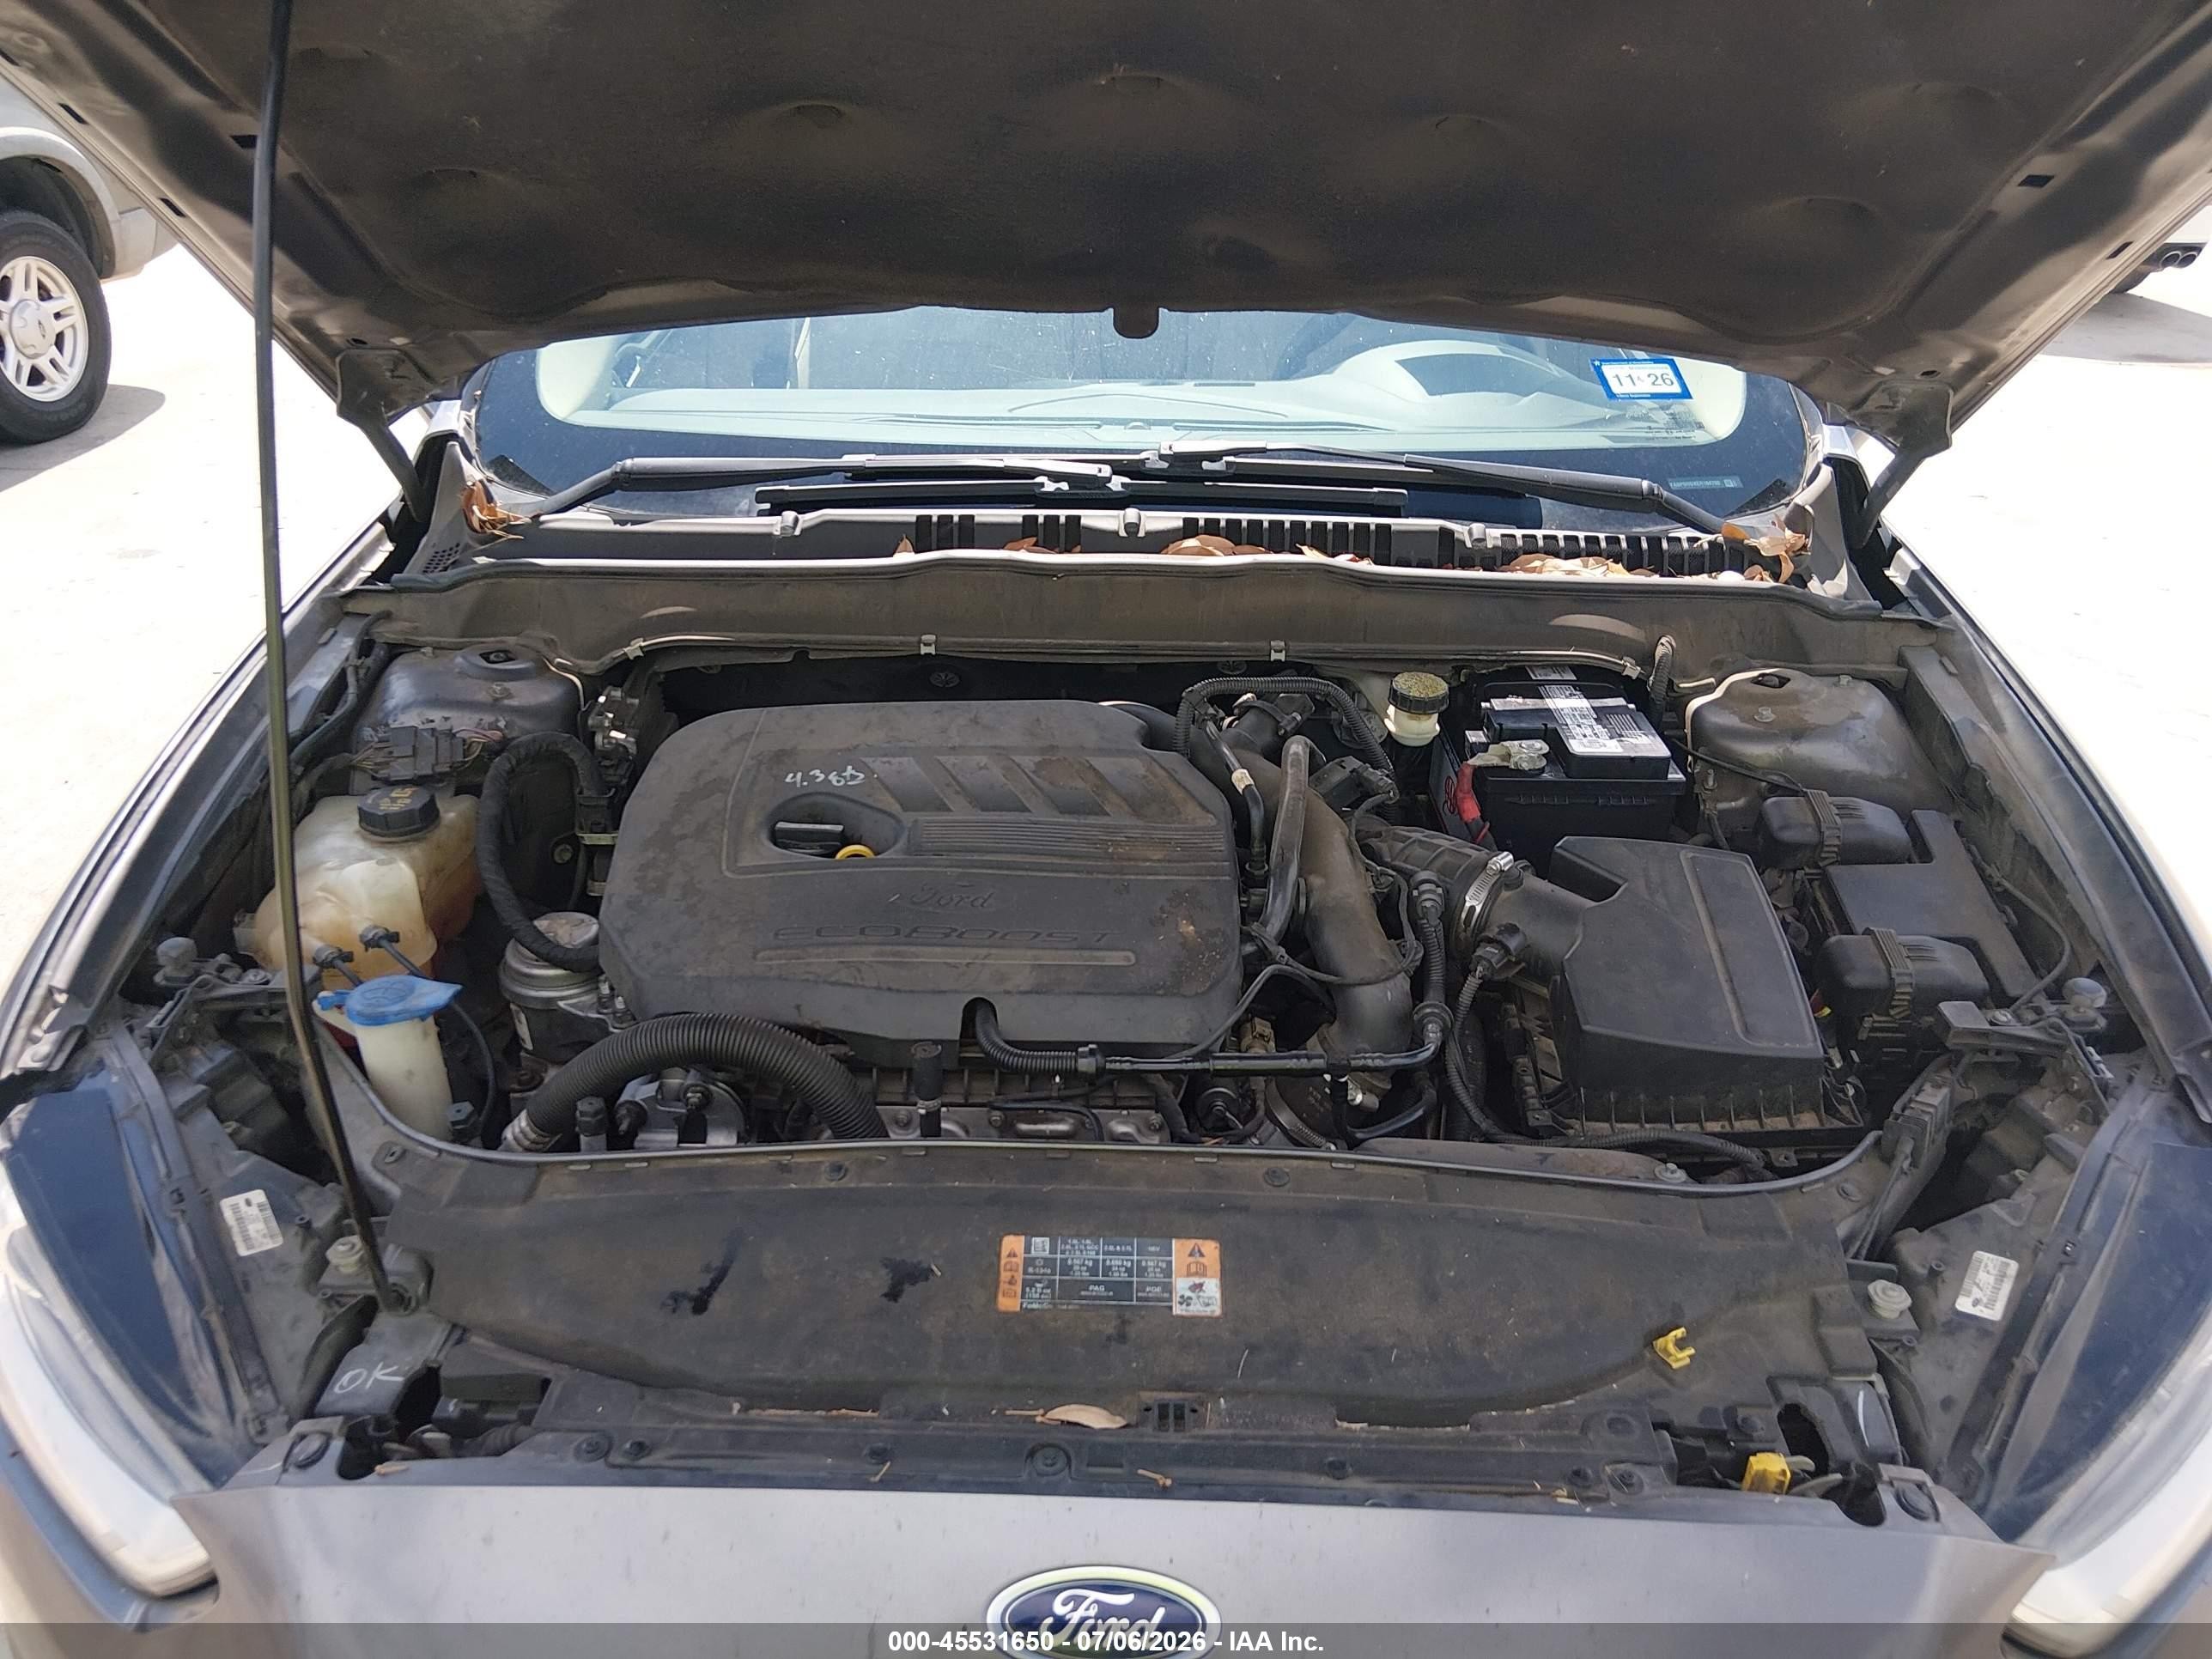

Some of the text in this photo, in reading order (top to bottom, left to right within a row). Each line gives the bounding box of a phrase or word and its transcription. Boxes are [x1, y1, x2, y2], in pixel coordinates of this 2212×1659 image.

[1612, 373, 1674, 387] 11 26
[911, 881, 995, 908] Ford
[773, 924, 1121, 945] ECOBOOST
[333, 1361, 405, 1395] OK
[1040, 1589, 1166, 1650] Ford
